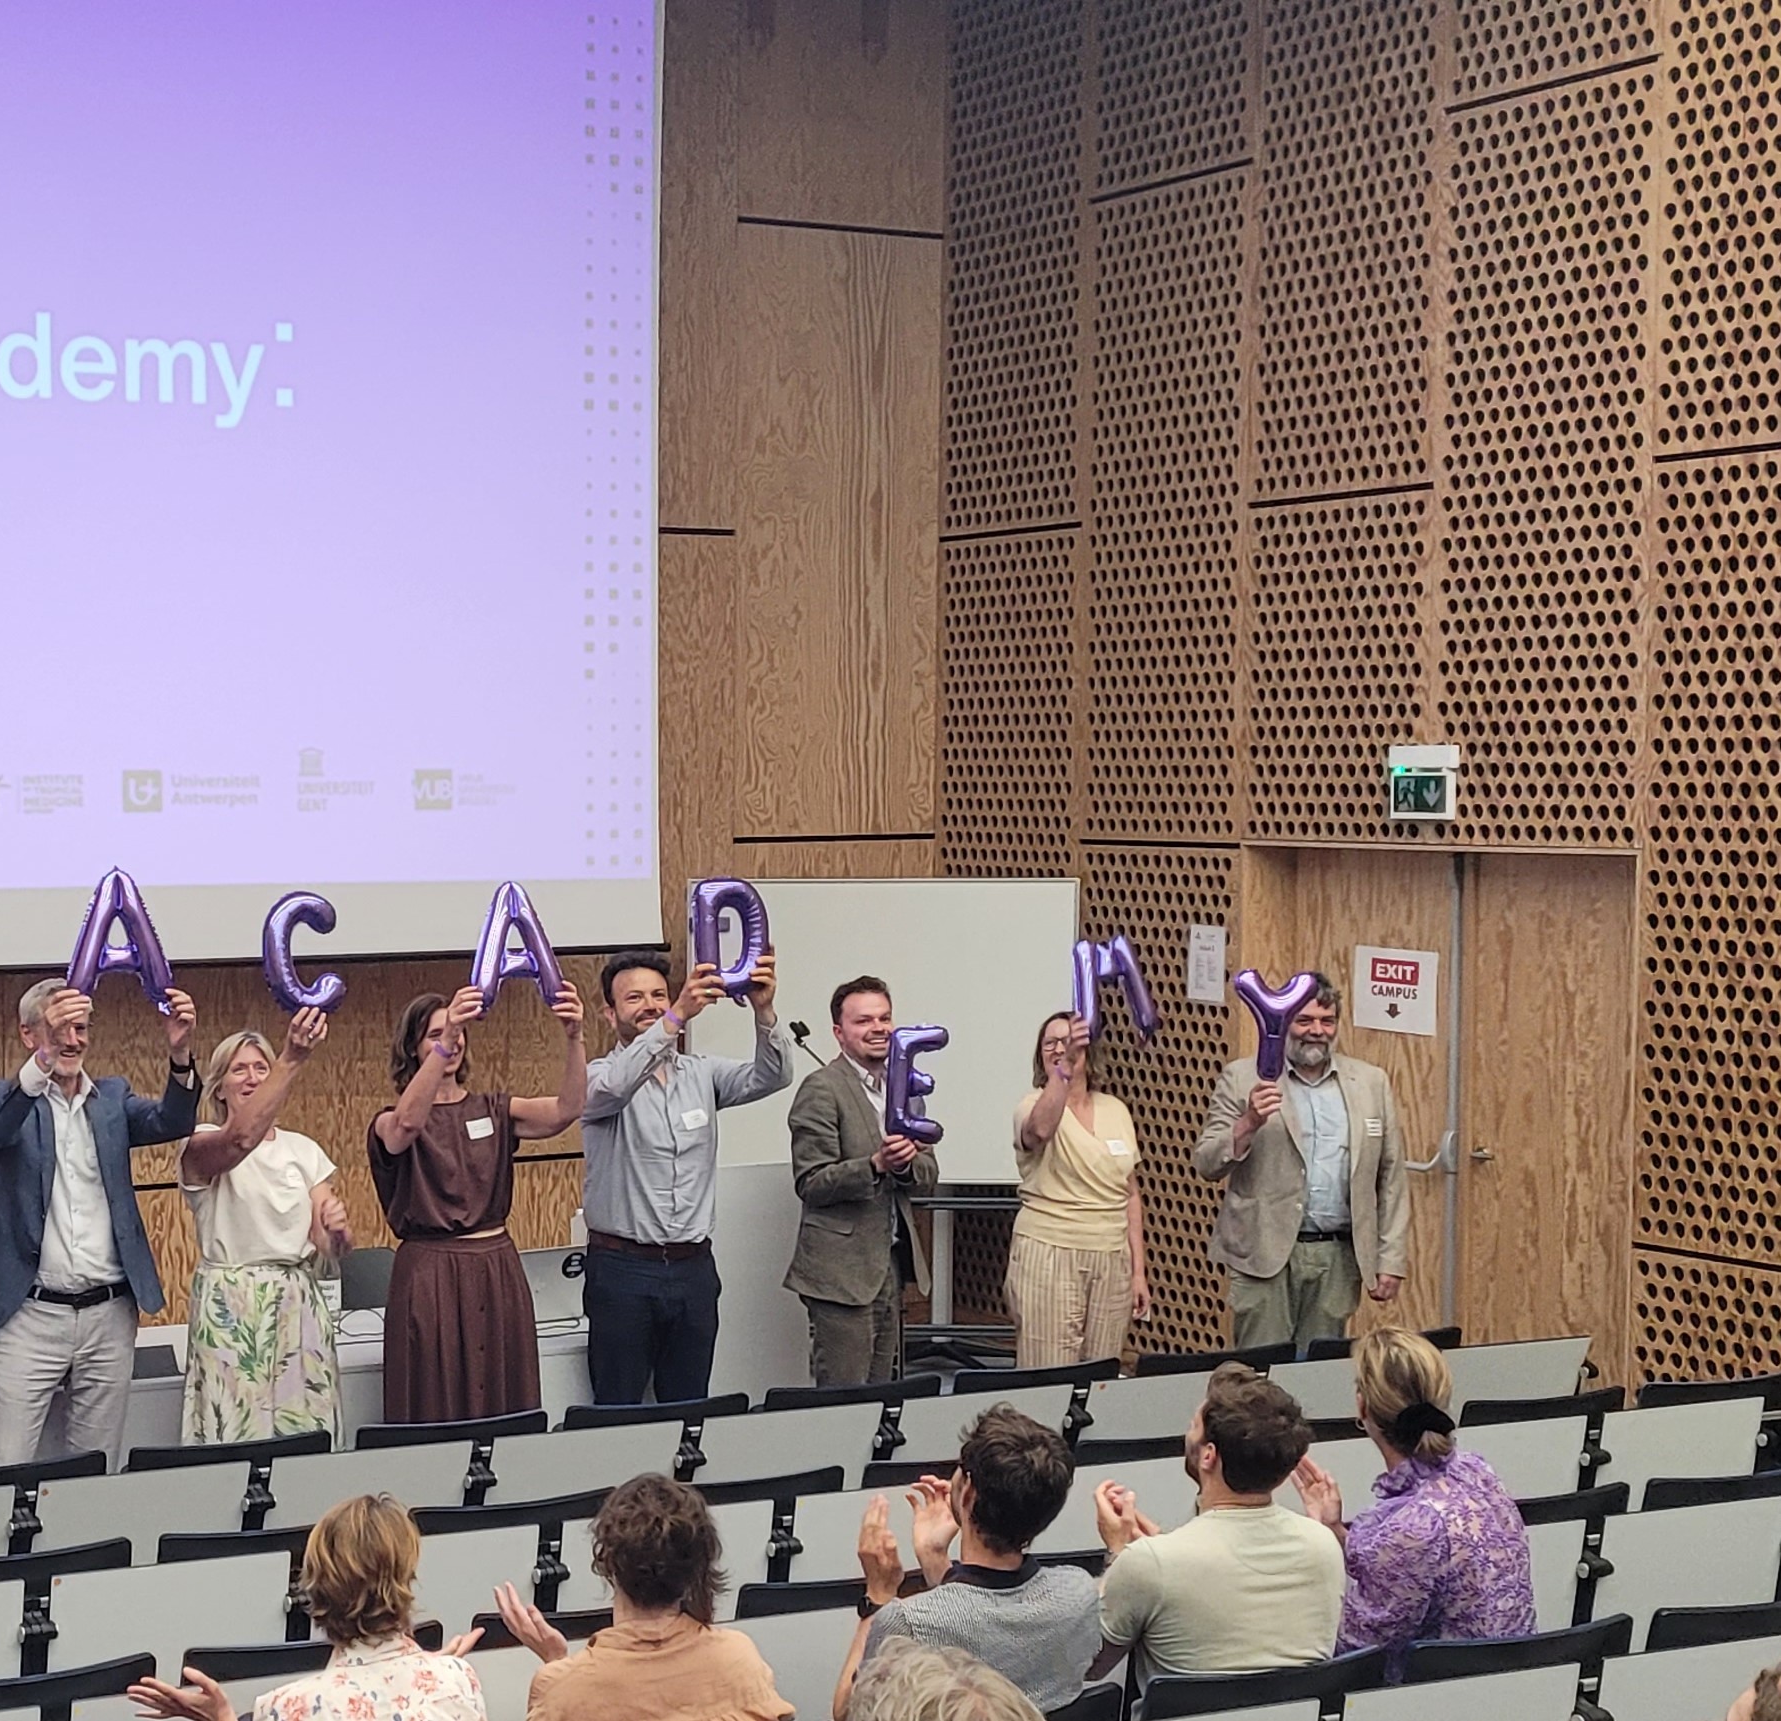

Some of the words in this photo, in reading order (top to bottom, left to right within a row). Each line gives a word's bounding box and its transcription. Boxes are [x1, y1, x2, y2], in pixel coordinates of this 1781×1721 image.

[171, 774, 260, 789] Universiteit
[171, 791, 258, 808] Antwerpen
[1375, 962, 1416, 981] EXIT
[1371, 984, 1418, 1000] CAMPUS
